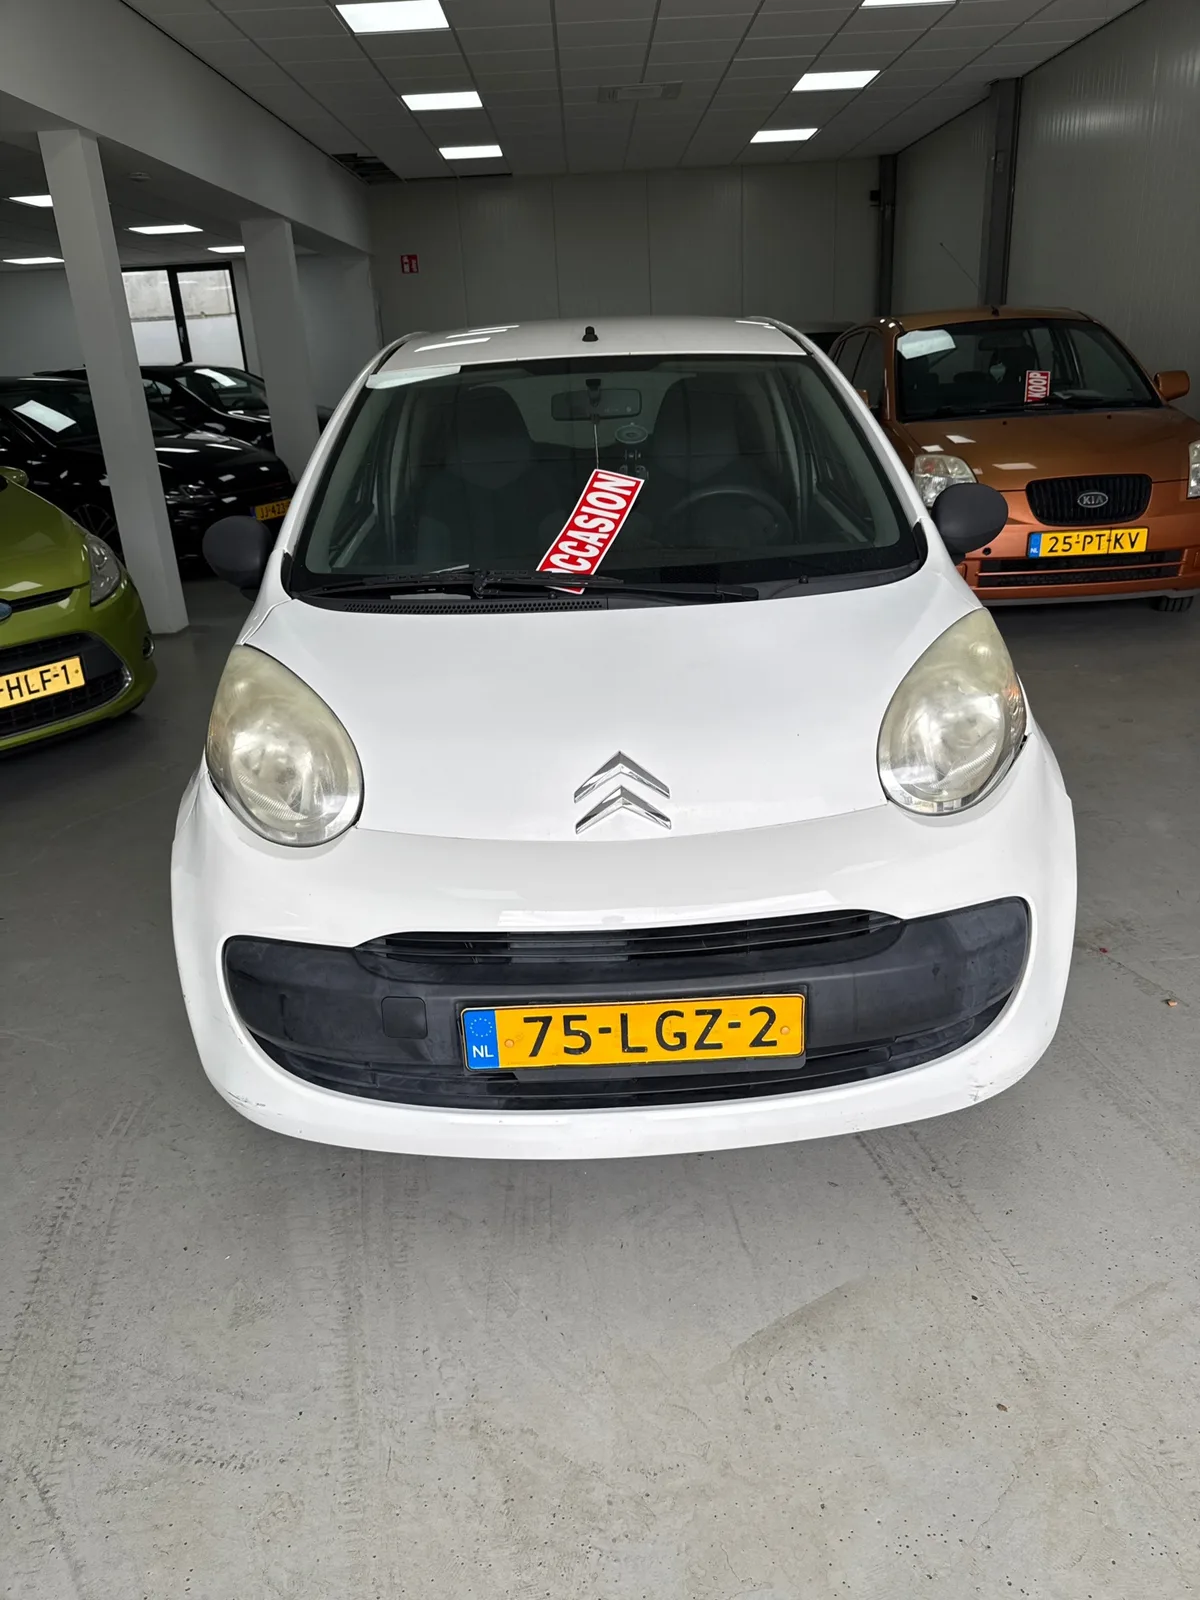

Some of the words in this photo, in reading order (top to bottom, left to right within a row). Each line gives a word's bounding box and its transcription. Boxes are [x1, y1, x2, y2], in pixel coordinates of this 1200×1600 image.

[1083, 495, 1103, 505] KIA
[1047, 532, 1140, 553] 25-PT-KV
[472, 1044, 494, 1059] NL
[522, 1005, 778, 1058] 75-LGZ-2
